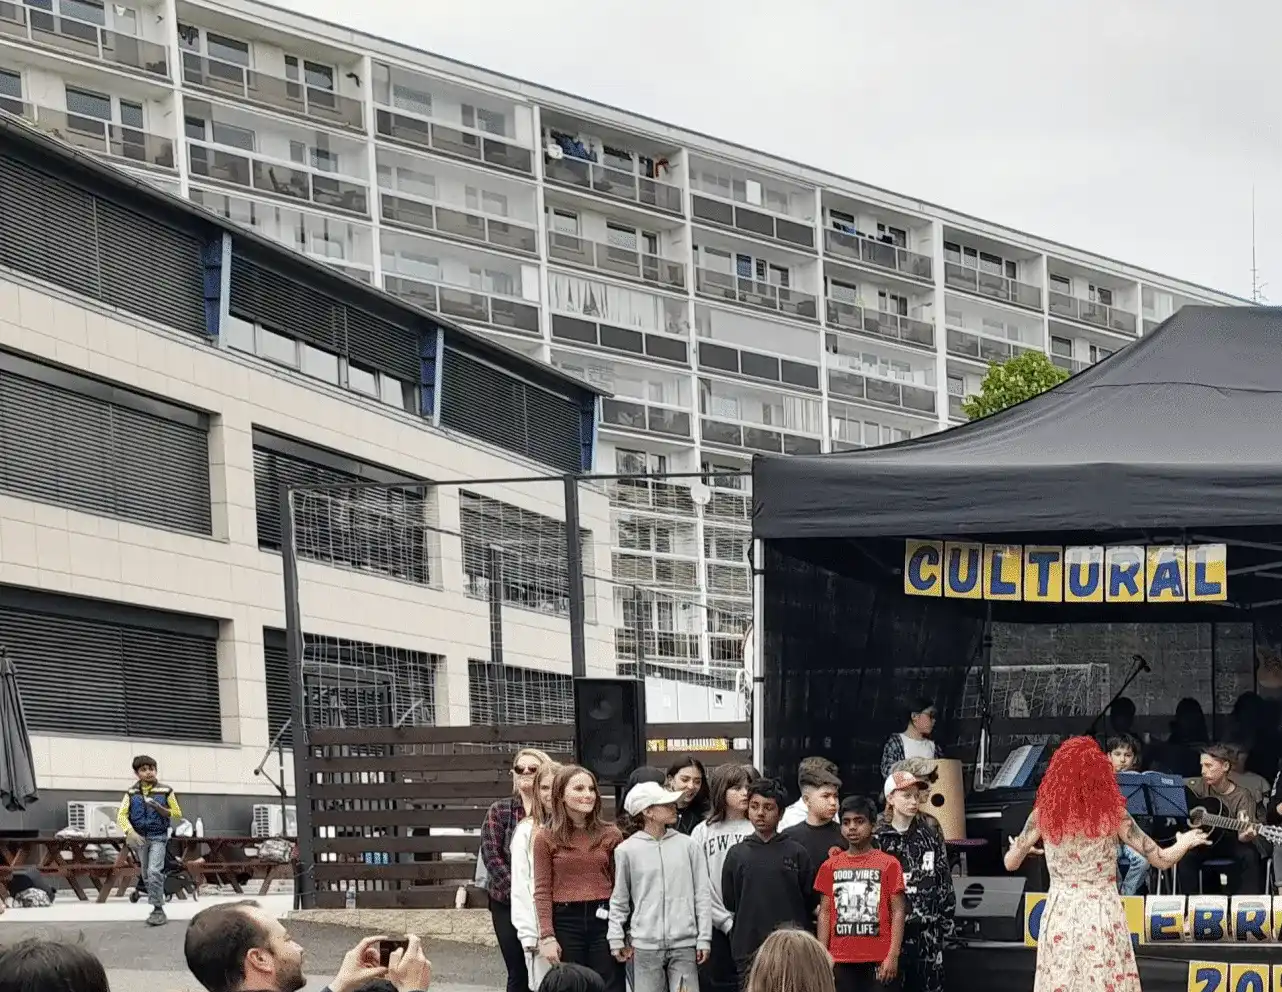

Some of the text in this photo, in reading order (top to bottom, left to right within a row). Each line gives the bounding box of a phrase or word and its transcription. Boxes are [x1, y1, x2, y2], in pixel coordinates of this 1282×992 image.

[908, 546, 1222, 598] CULTURAL
[833, 869, 880, 881] GOOD VIBES
[836, 923, 874, 936] CITY LIFE
